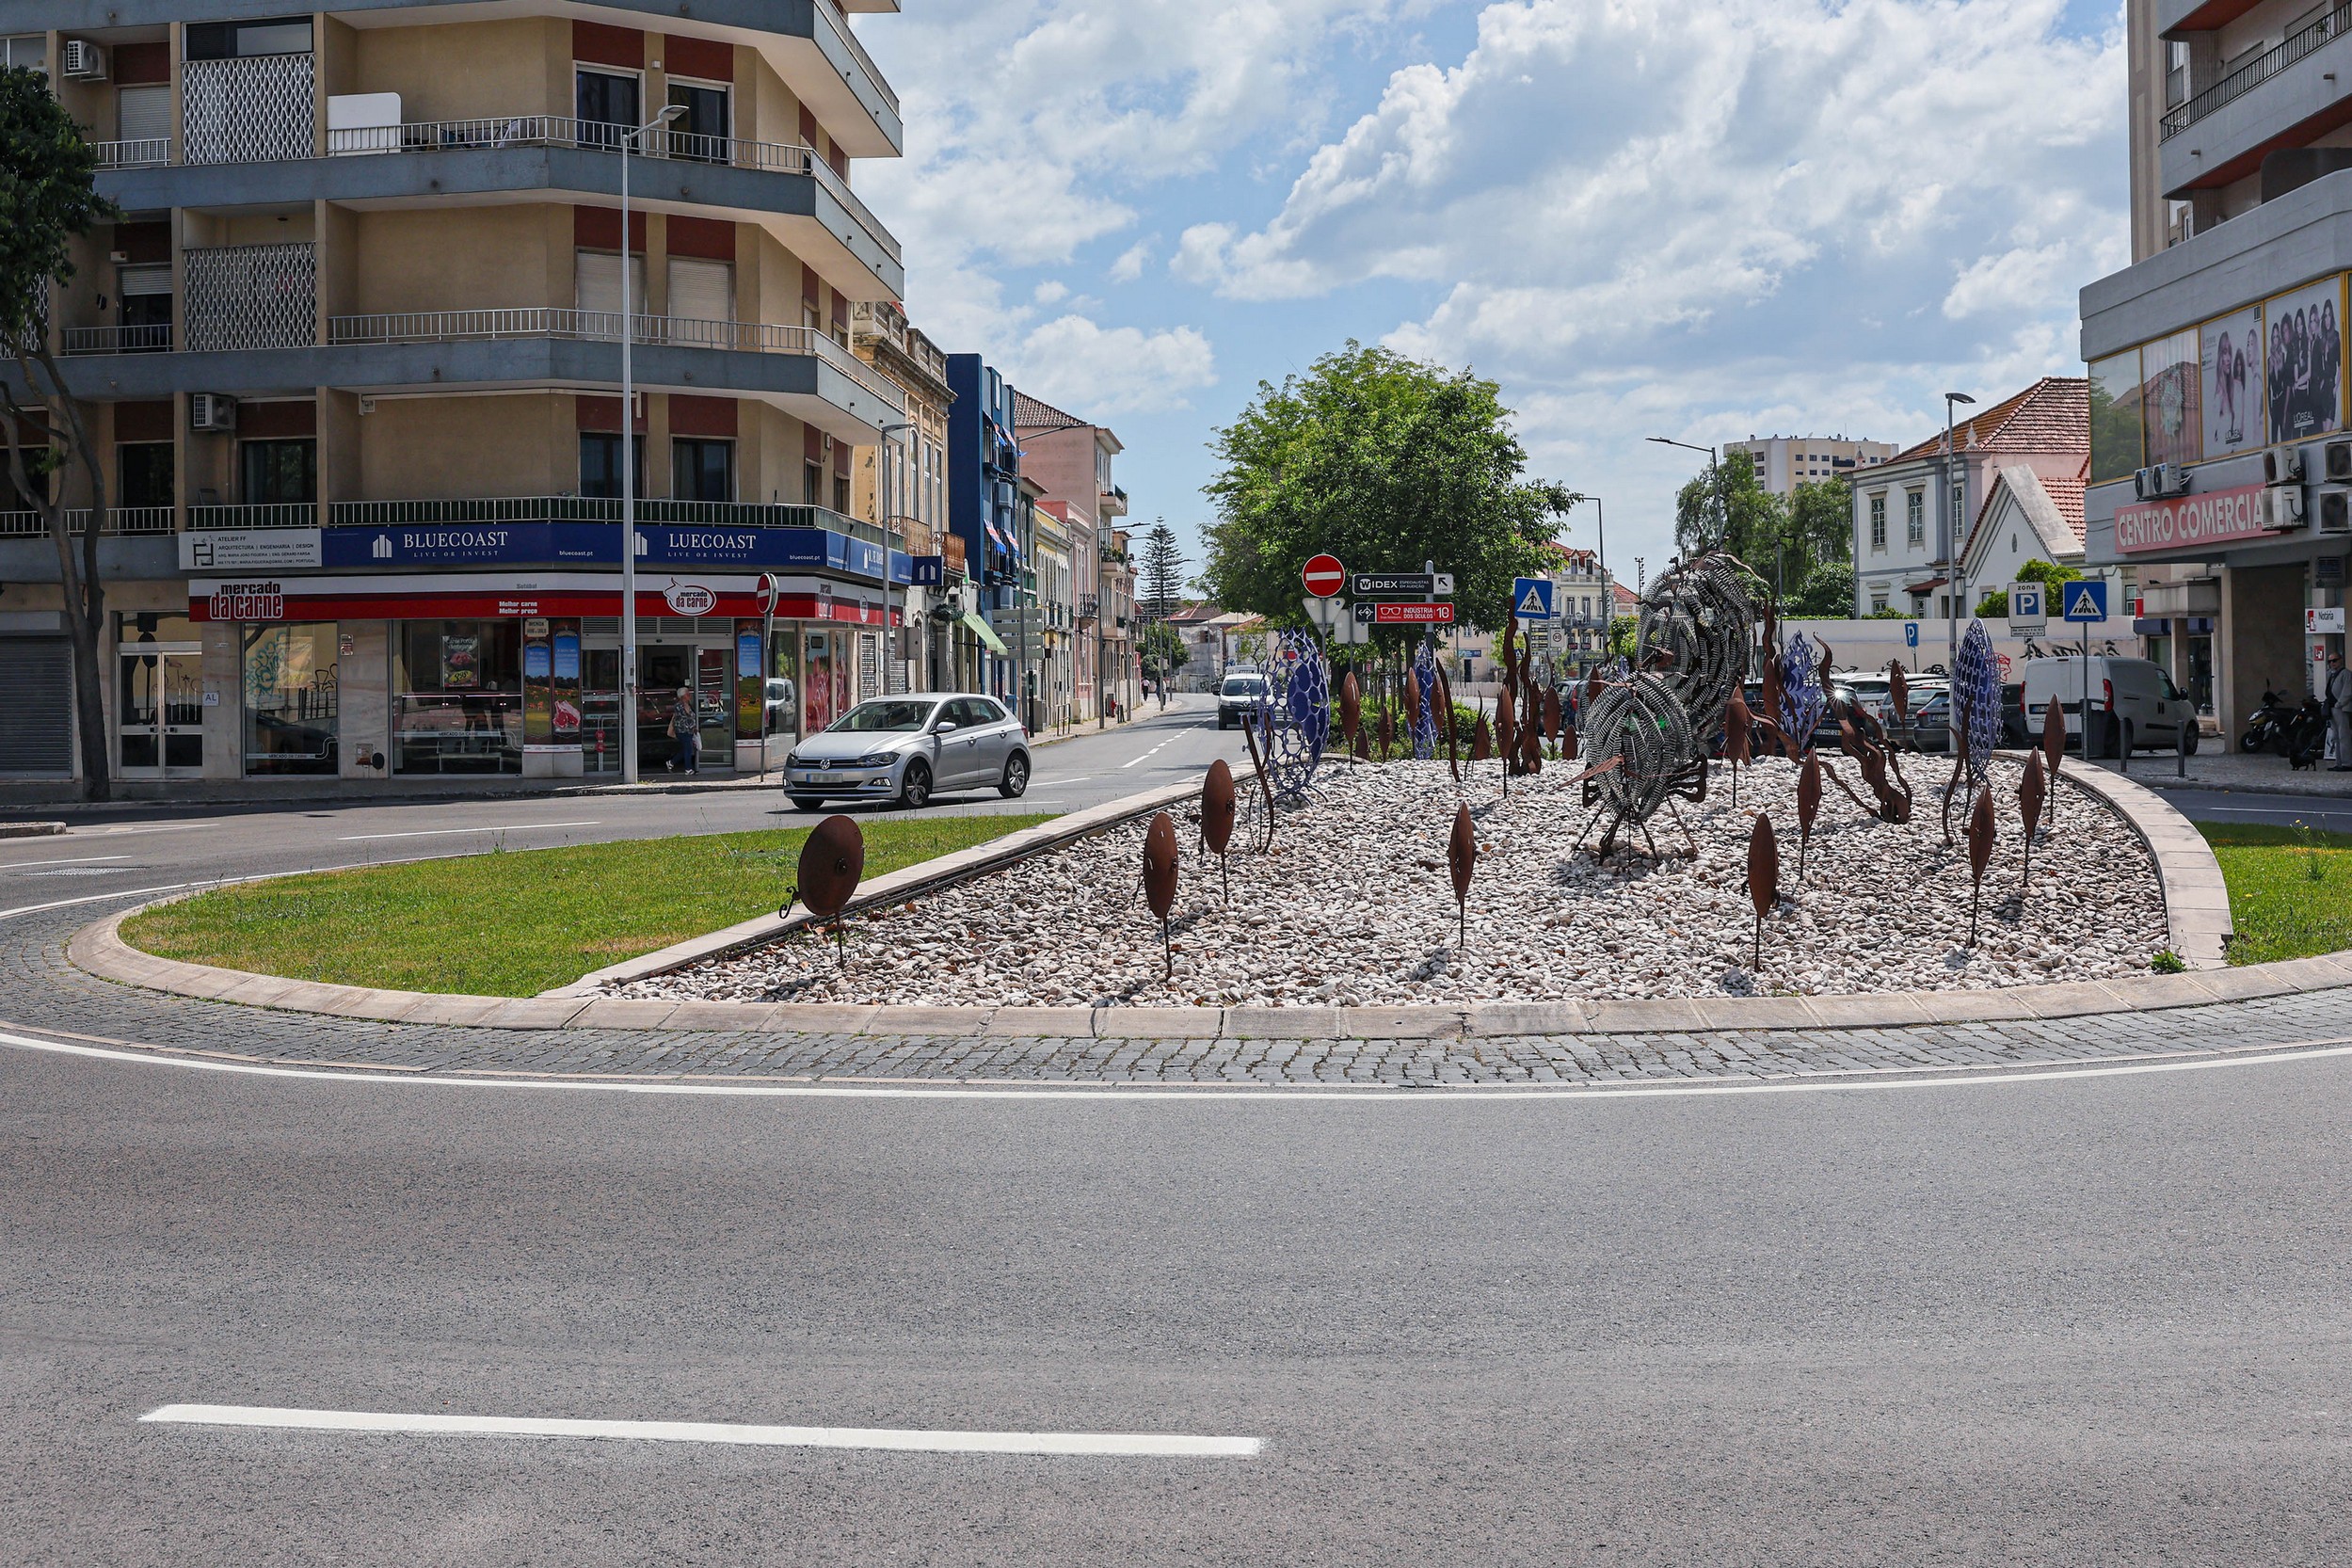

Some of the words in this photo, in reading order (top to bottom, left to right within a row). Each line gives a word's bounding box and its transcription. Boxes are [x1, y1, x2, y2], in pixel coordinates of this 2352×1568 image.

[2118, 506, 2173, 547] CENTRO
[404, 531, 508, 549] BLUECOAST
[668, 533, 757, 550] LUECOAST
[221, 582, 280, 595] mercado
[1359, 578, 1398, 590] WIDEX
[210, 592, 231, 619] da
[234, 594, 282, 619] carne
[676, 596, 685, 608] da
[686, 597, 708, 608] carne
[1403, 605, 1433, 614] INDÚSTRIA
[2020, 594, 2035, 615] P
[2318, 610, 2334, 620] Notária
[1907, 625, 1915, 643] P
